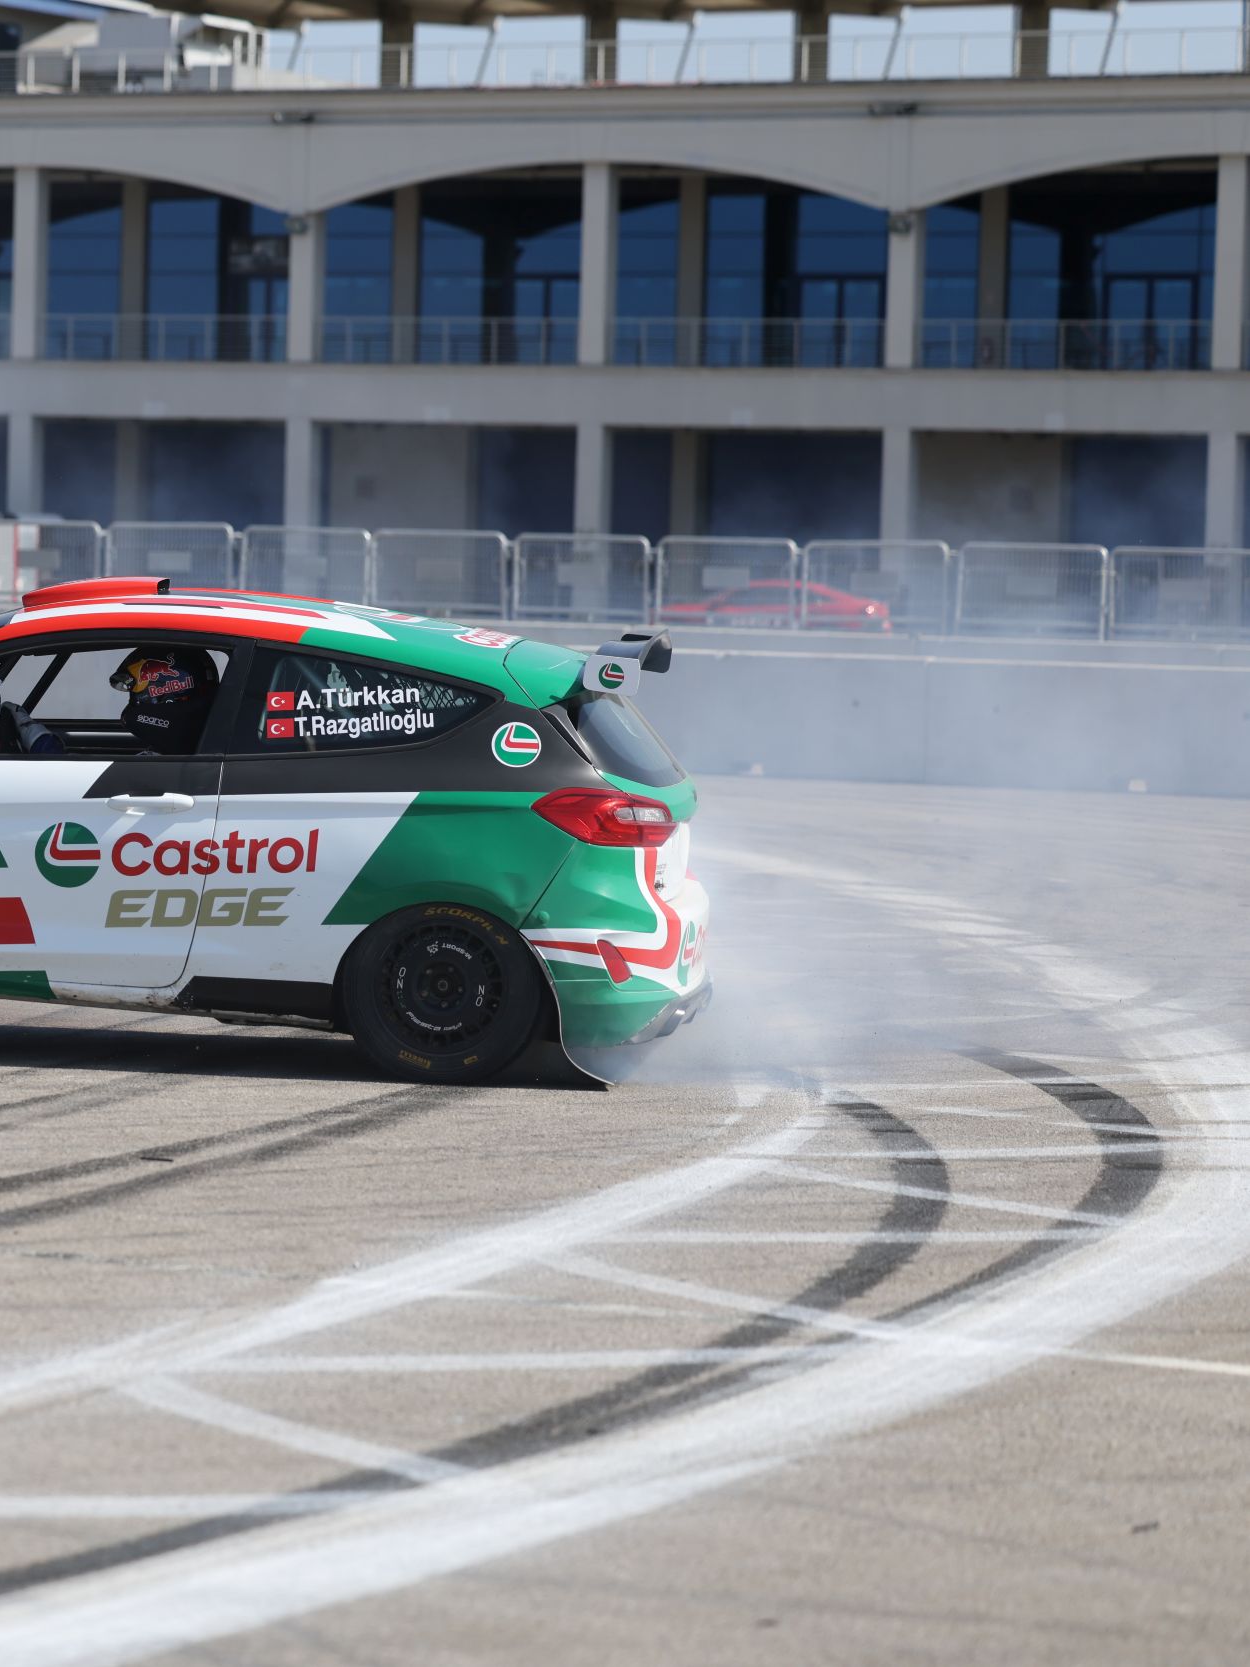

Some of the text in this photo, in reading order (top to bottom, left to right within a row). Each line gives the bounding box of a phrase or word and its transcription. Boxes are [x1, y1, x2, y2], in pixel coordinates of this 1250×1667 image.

[296, 685, 420, 711] A.Türkkan
[137, 714, 170, 728] sparco
[294, 708, 434, 738] T.Razgatlıoğlu
[111, 829, 319, 876] Castrol
[104, 887, 296, 928] EDGE
[424, 907, 509, 945] SCORPIN
